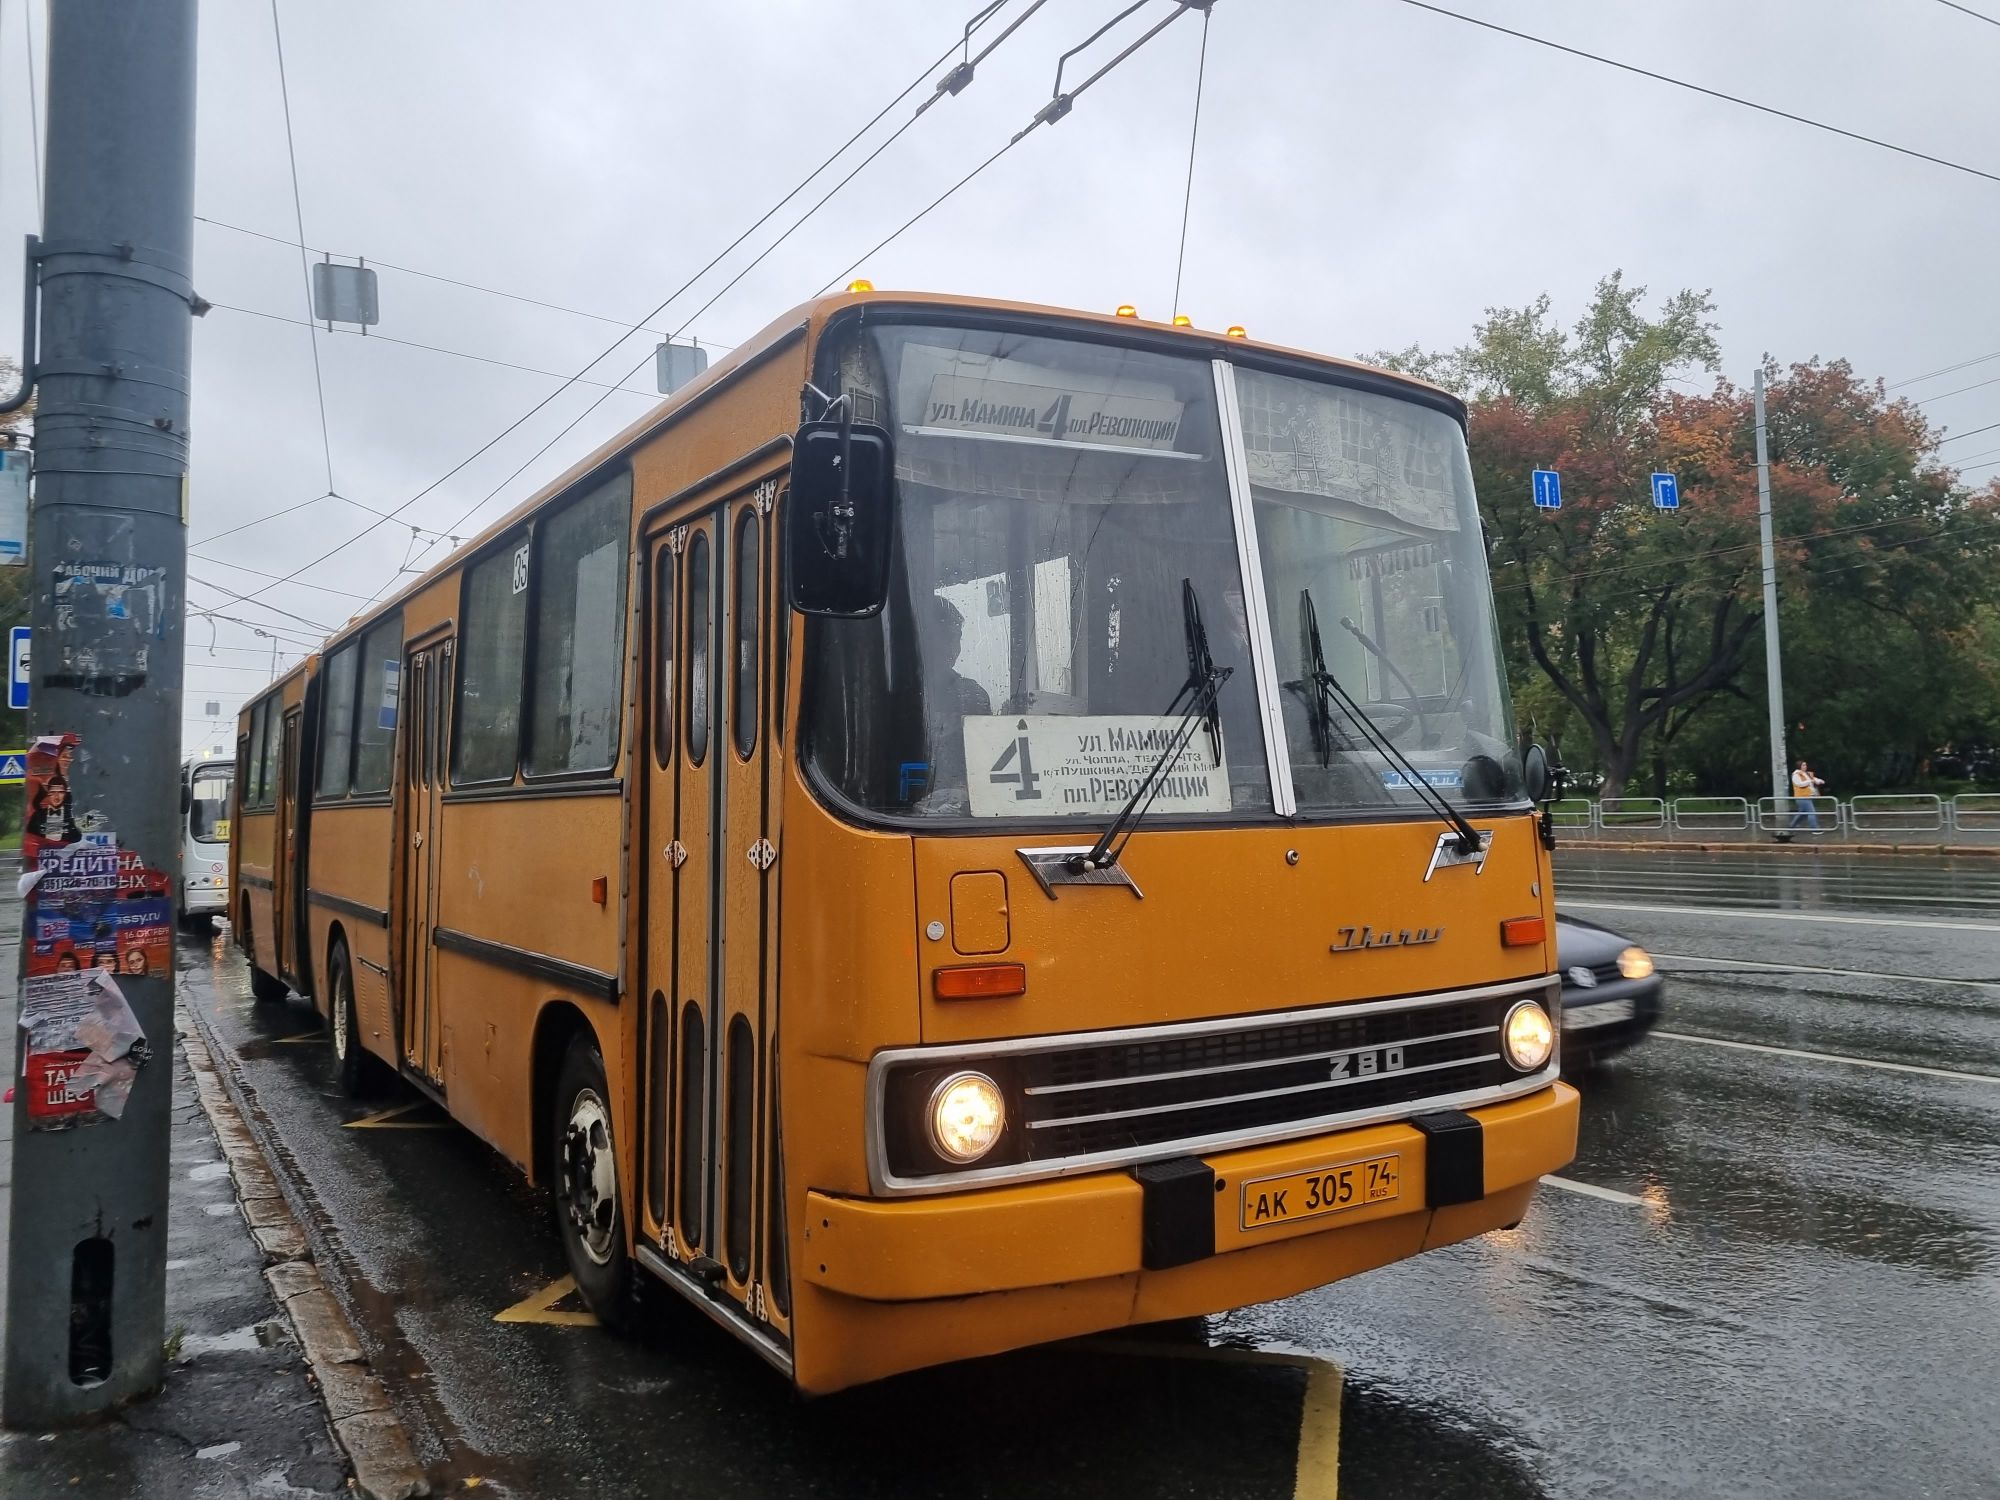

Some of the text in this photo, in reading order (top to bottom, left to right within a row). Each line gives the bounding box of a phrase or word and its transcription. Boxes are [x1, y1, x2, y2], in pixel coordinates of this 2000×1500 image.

[1036, 395, 1072, 440] 4
[62, 563, 154, 585] АБОЧИЙ ДО
[989, 736, 1042, 800] 4
[1134, 753, 1175, 763] ТЕАР
[1305, 1171, 1353, 1210] 305
[1367, 1162, 1391, 1189] 74
[1370, 1188, 1389, 1198] RUS
